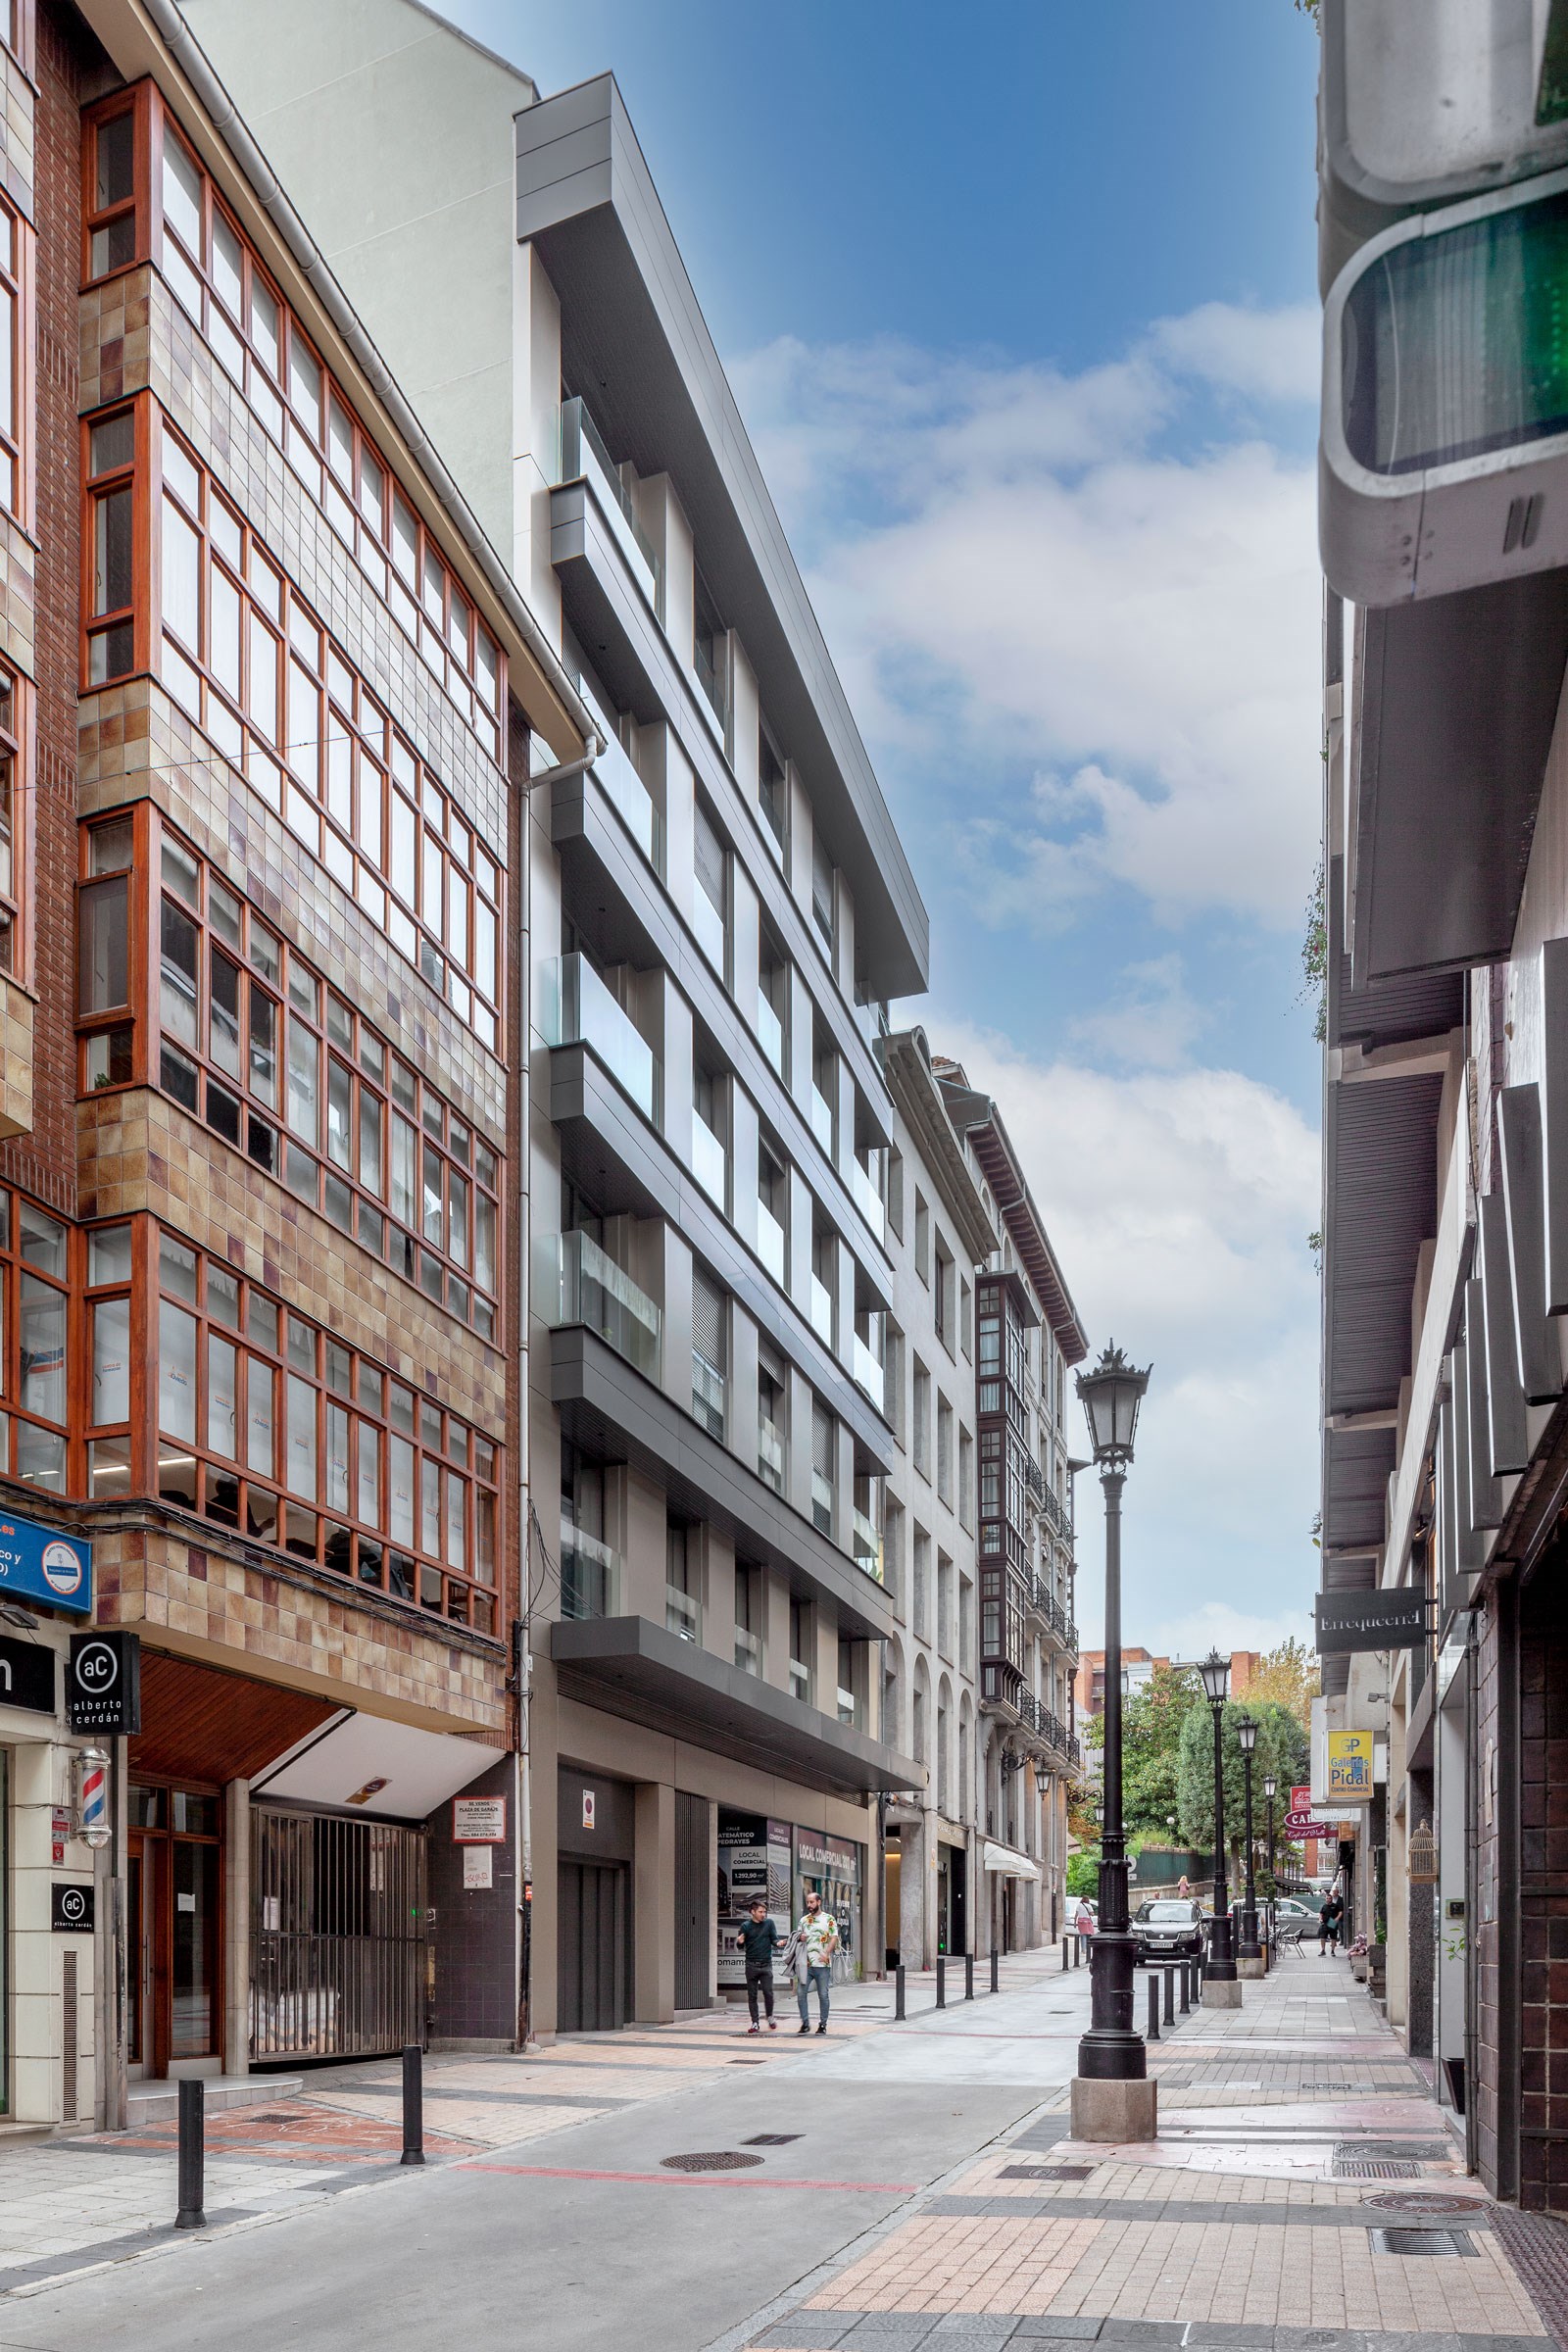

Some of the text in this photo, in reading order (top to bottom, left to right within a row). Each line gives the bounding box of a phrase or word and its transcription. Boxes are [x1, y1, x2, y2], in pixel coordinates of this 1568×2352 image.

[14, 1554, 22, 1565] y
[84, 1655, 108, 1677] aC
[74, 1700, 122, 1711] alberto
[76, 1712, 119, 1724] cerdán
[1331, 1756, 1369, 1768] Galerías
[1331, 1768, 1369, 1785] Pidal
[799, 1843, 815, 1862] LOCAL
[815, 1847, 843, 1868] COMERCIAL
[66, 1897, 80, 1910] aC
